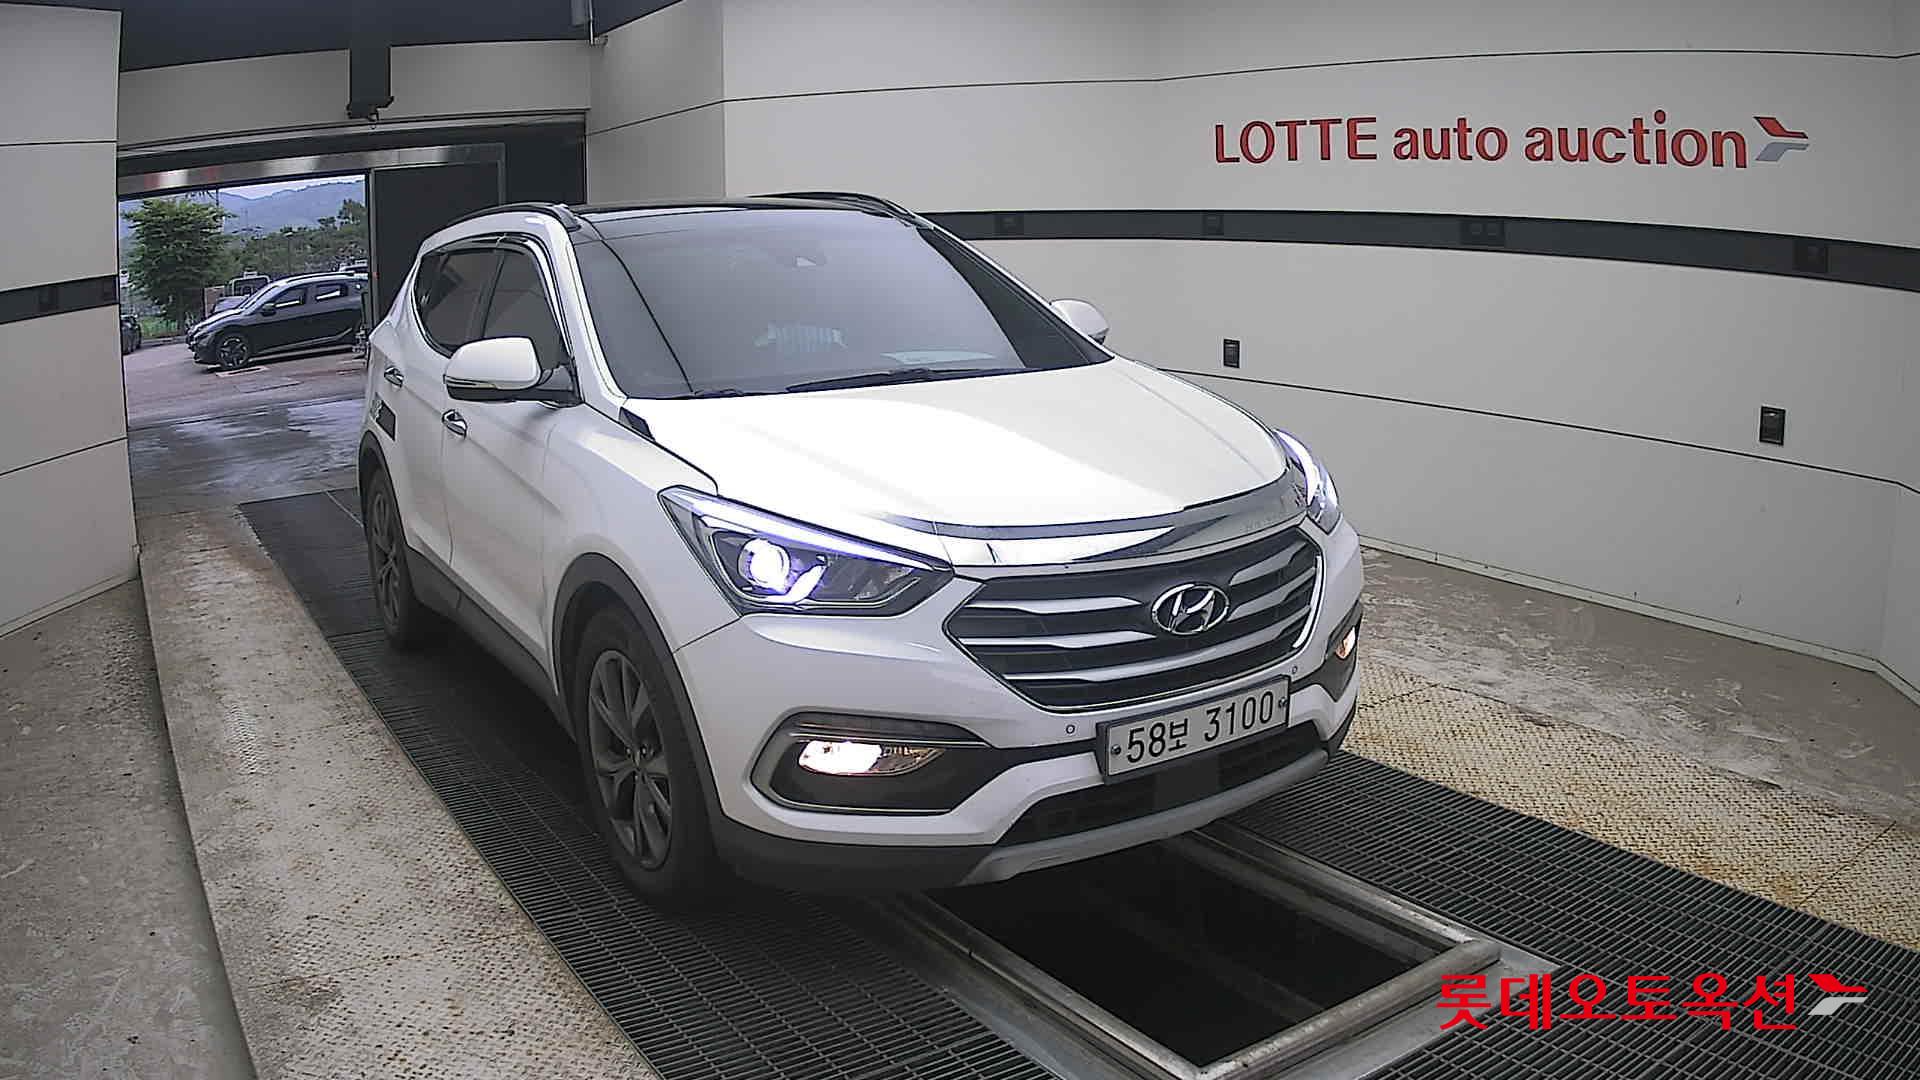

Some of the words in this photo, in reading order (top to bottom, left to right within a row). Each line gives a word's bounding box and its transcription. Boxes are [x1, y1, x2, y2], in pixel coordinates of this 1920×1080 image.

[1215, 116, 1377, 164] LOTTE
[1392, 116, 1508, 162] auto
[1523, 109, 1747, 169] auction
[1126, 718, 1189, 764] 58보
[1204, 690, 1274, 743] 3100
